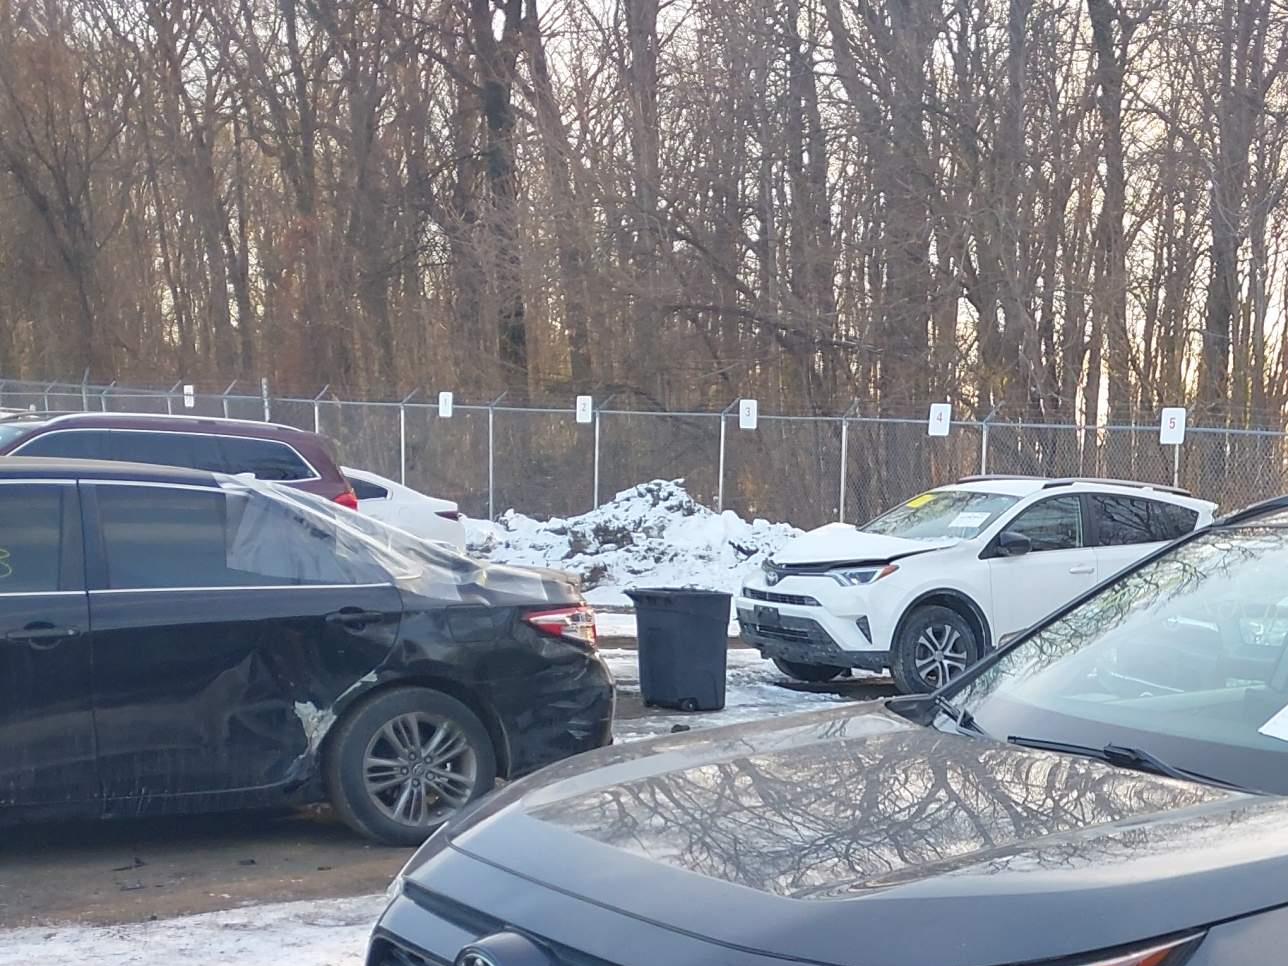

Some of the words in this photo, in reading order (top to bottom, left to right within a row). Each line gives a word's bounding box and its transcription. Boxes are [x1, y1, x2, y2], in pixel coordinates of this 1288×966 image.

[581, 402, 587, 413] 2
[744, 407, 751, 418] 3
[936, 412, 943, 423] 4
[1168, 417, 1176, 429] 5
